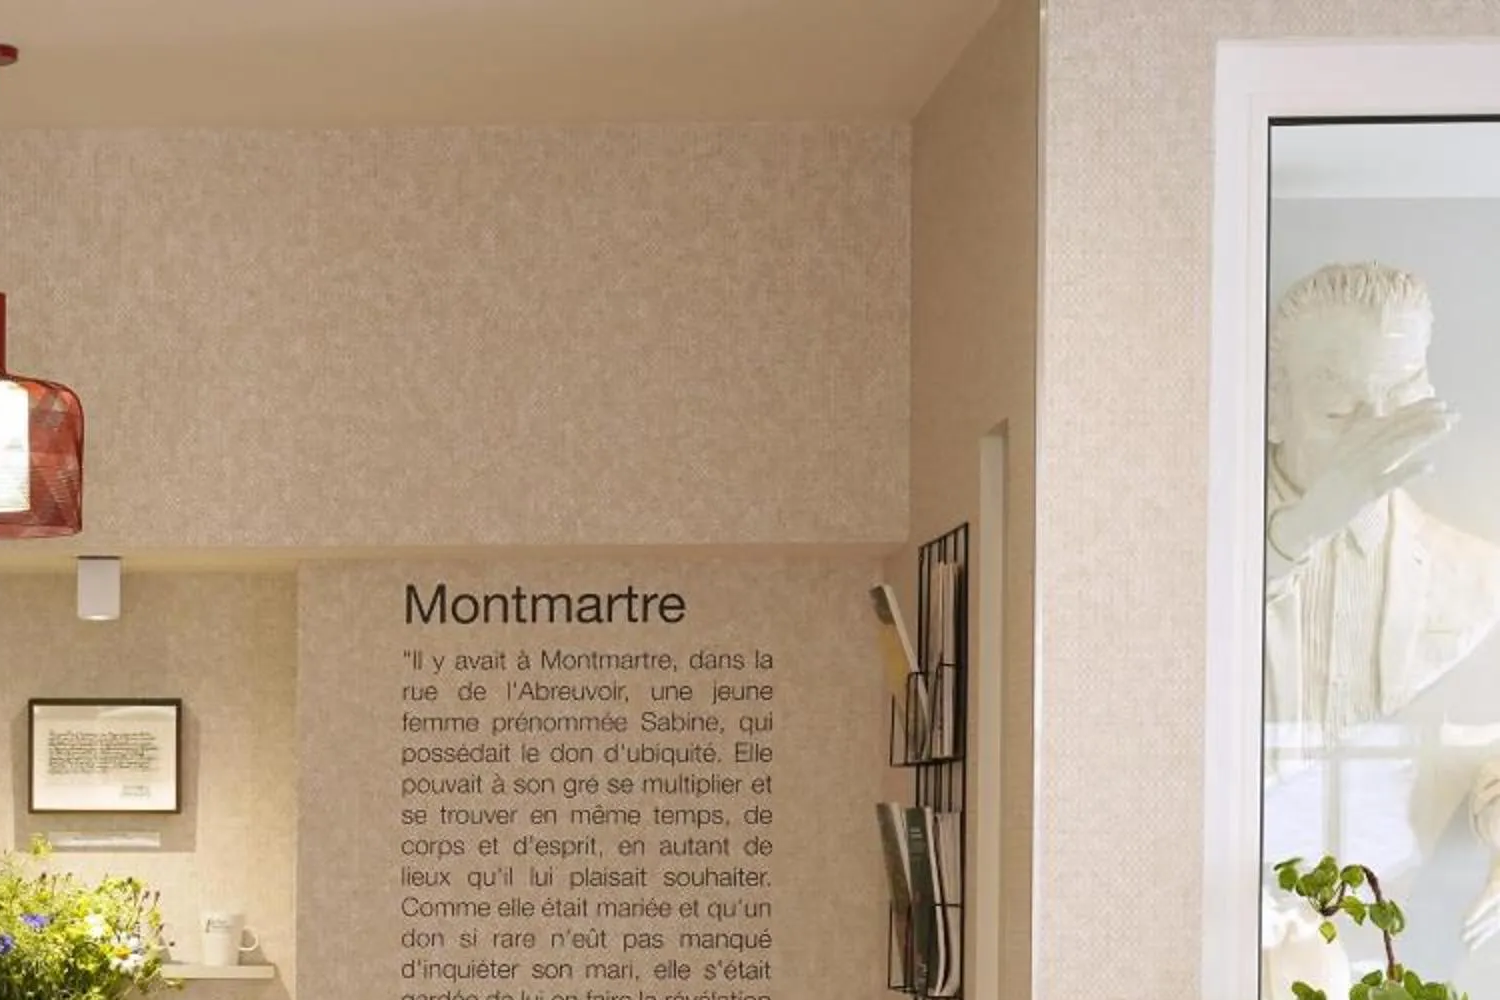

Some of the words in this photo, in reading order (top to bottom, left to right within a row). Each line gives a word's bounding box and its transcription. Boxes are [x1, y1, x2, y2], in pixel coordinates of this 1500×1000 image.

[405, 583, 687, 625] Montmartre
[403, 649, 423, 671] "Il
[432, 655, 446, 675] y
[454, 651, 506, 671] avait
[516, 649, 531, 671] à
[541, 649, 678, 673] Montmartre,
[689, 649, 745, 671] dans
[754, 649, 774, 670] la
[402, 684, 439, 702] rue
[457, 681, 487, 702] de
[507, 681, 629, 703] l'Abreuvoir,
[651, 684, 693, 702] une
[712, 684, 774, 705] jeune
[402, 711, 480, 733] femme
[491, 712, 628, 736] prénommée
[640, 711, 725, 734] Sabine,
[739, 711, 773, 736] qui
[401, 743, 511, 767] possédait
[521, 743, 540, 764] le
[549, 743, 594, 763] don
[603, 743, 722, 767] d'ubiquité.
[734, 741, 773, 763] Elle
[401, 775, 482, 798] pouvait
[491, 773, 505, 795] à
[513, 777, 555, 795] son
[562, 777, 600, 799] gré
[607, 777, 635, 795] se
[642, 773, 743, 796] multiplier
[750, 775, 773, 795] et
[401, 808, 427, 825] se
[439, 805, 518, 825] trouver
[529, 808, 557, 825] en
[570, 804, 641, 826] même
[653, 807, 730, 829] temps,
[743, 804, 773, 825] de
[400, 839, 465, 860] corps
[477, 837, 499, 857] et
[512, 835, 603, 859] d'esprit,
[617, 839, 646, 857] en
[659, 837, 729, 857] autant
[743, 835, 773, 857] de
[401, 866, 451, 887] lieux
[467, 866, 513, 891] qu'il
[530, 867, 553, 888] lui
[569, 867, 647, 890] plaisait
[663, 867, 771, 888] souhaiter.
[400, 896, 491, 918] Comme
[497, 897, 536, 917] elle
[541, 898, 588, 918] était
[596, 897, 673, 918] mariée
[678, 899, 699, 918] et
[707, 899, 772, 922] qu'un
[400, 927, 445, 949] don
[459, 928, 478, 949] si
[493, 932, 536, 949] rare
[551, 927, 607, 949] n'eût
[623, 932, 665, 953] pas
[679, 928, 773, 953] manqué
[400, 958, 520, 983] d'inquiéter
[531, 963, 573, 980] son
[585, 959, 640, 981] mari,
[653, 959, 691, 981] elle
[704, 959, 771, 981] s'était
